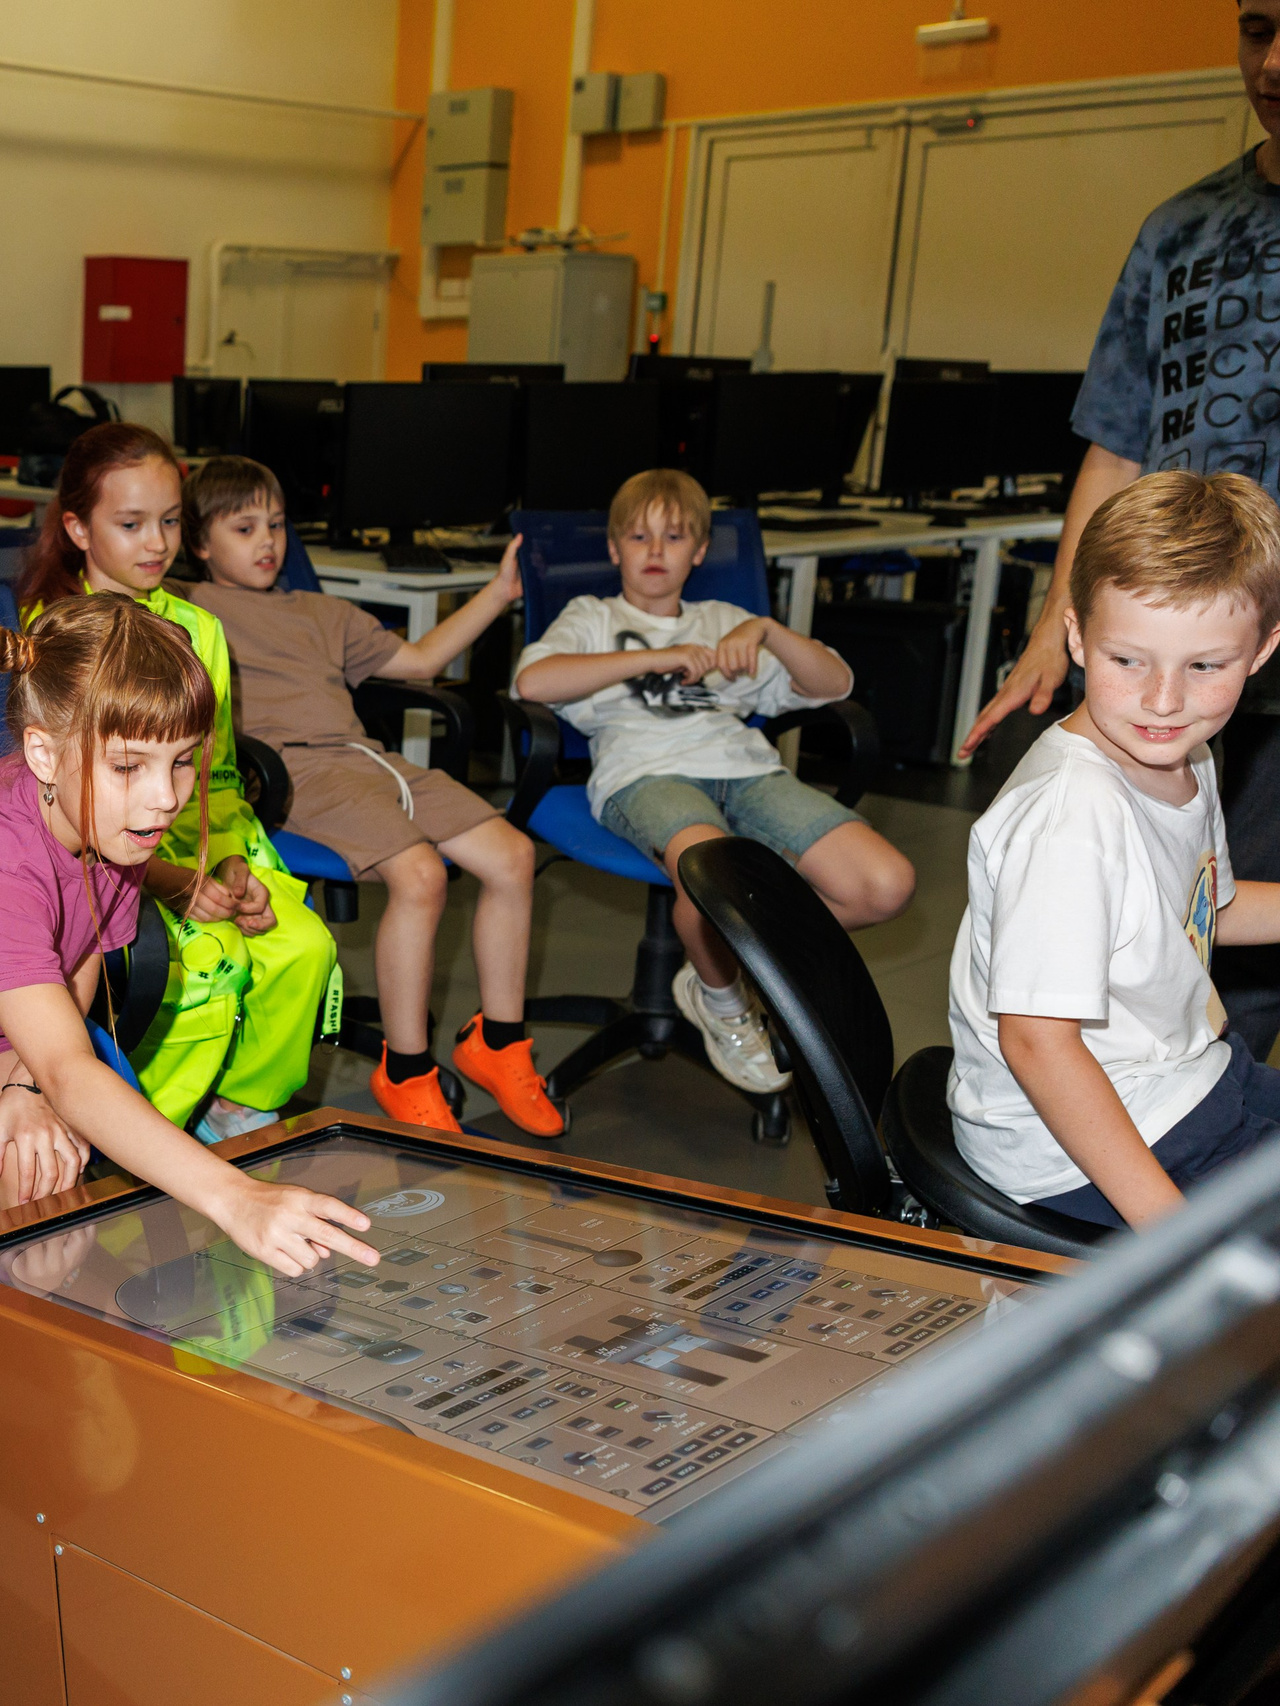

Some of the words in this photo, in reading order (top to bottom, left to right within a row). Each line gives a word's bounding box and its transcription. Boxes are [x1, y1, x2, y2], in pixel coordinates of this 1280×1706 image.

[1162, 340, 1280, 397] RECY
[644, 1328, 664, 1336] ENG
[275, 1352, 299, 1362] FLAPS
[382, 1349, 403, 1357] FLAPS
